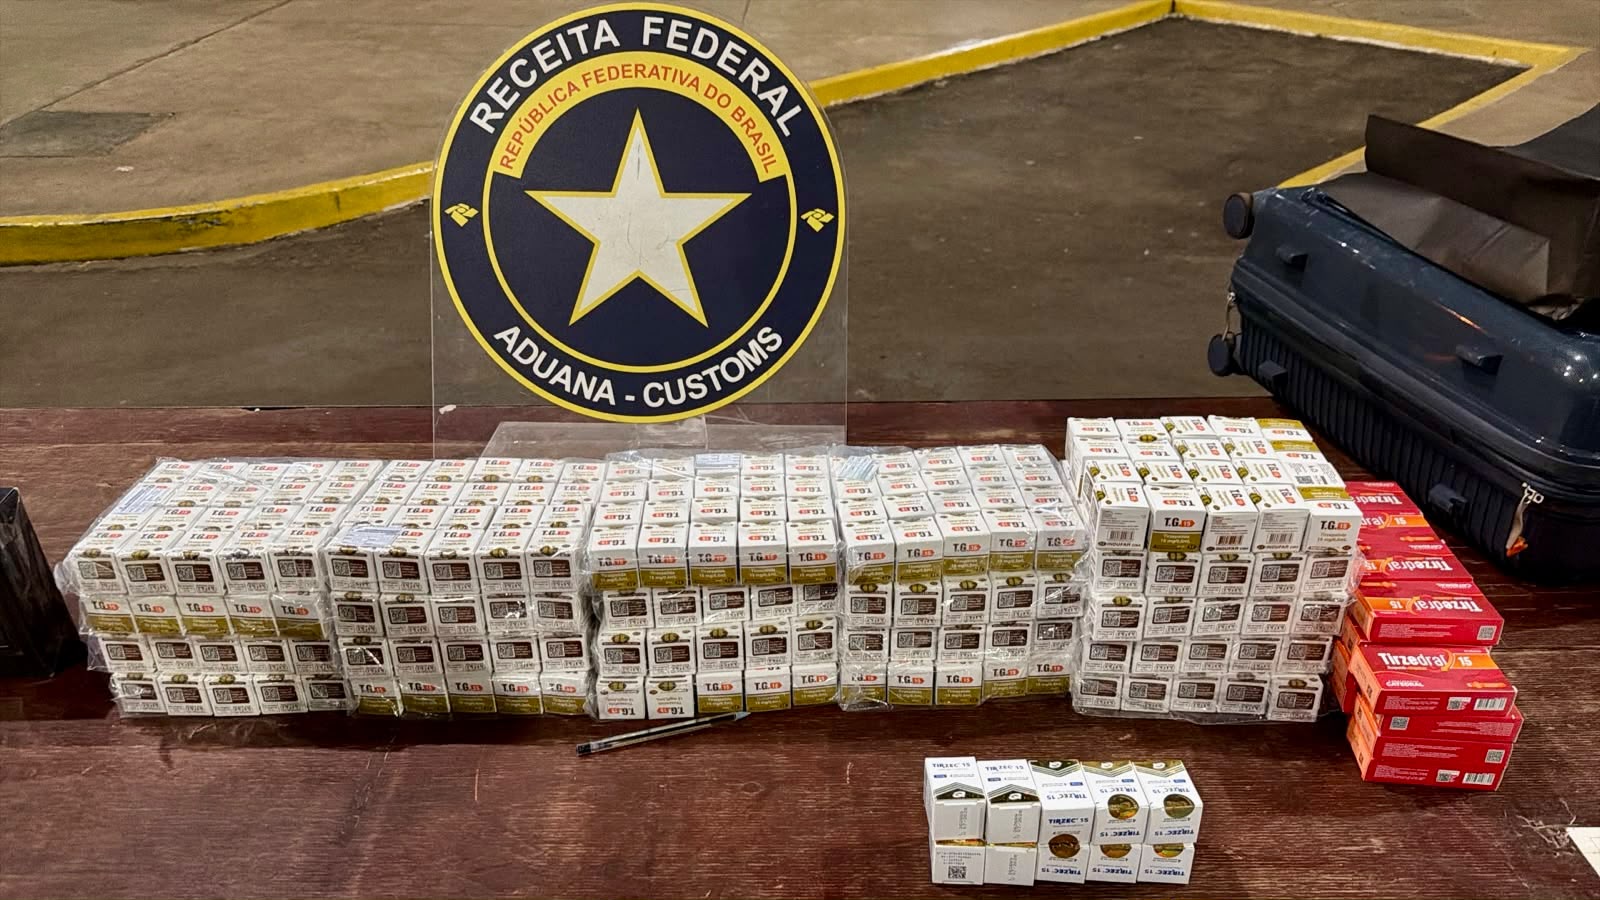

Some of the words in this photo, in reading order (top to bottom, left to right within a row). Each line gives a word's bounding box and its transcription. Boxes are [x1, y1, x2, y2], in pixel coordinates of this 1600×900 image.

[470, 19, 620, 134] RECEITA
[642, 16, 802, 137] FEDERAL
[500, 80, 581, 170] REPÚBLICA
[582, 63, 700, 89] FEDERATIVA
[704, 83, 732, 109] DO
[730, 106, 780, 173] BRASIL
[494, 325, 615, 406] ADUANA
[643, 326, 783, 408] CUSTOMS
[1351, 494, 1402, 504] Tirzedr
[1388, 560, 1453, 571] Tirzedral
[1414, 601, 1482, 612] Tirzedral
[1378, 653, 1446, 666] Tirzedral
[1458, 657, 1472, 666] 15
